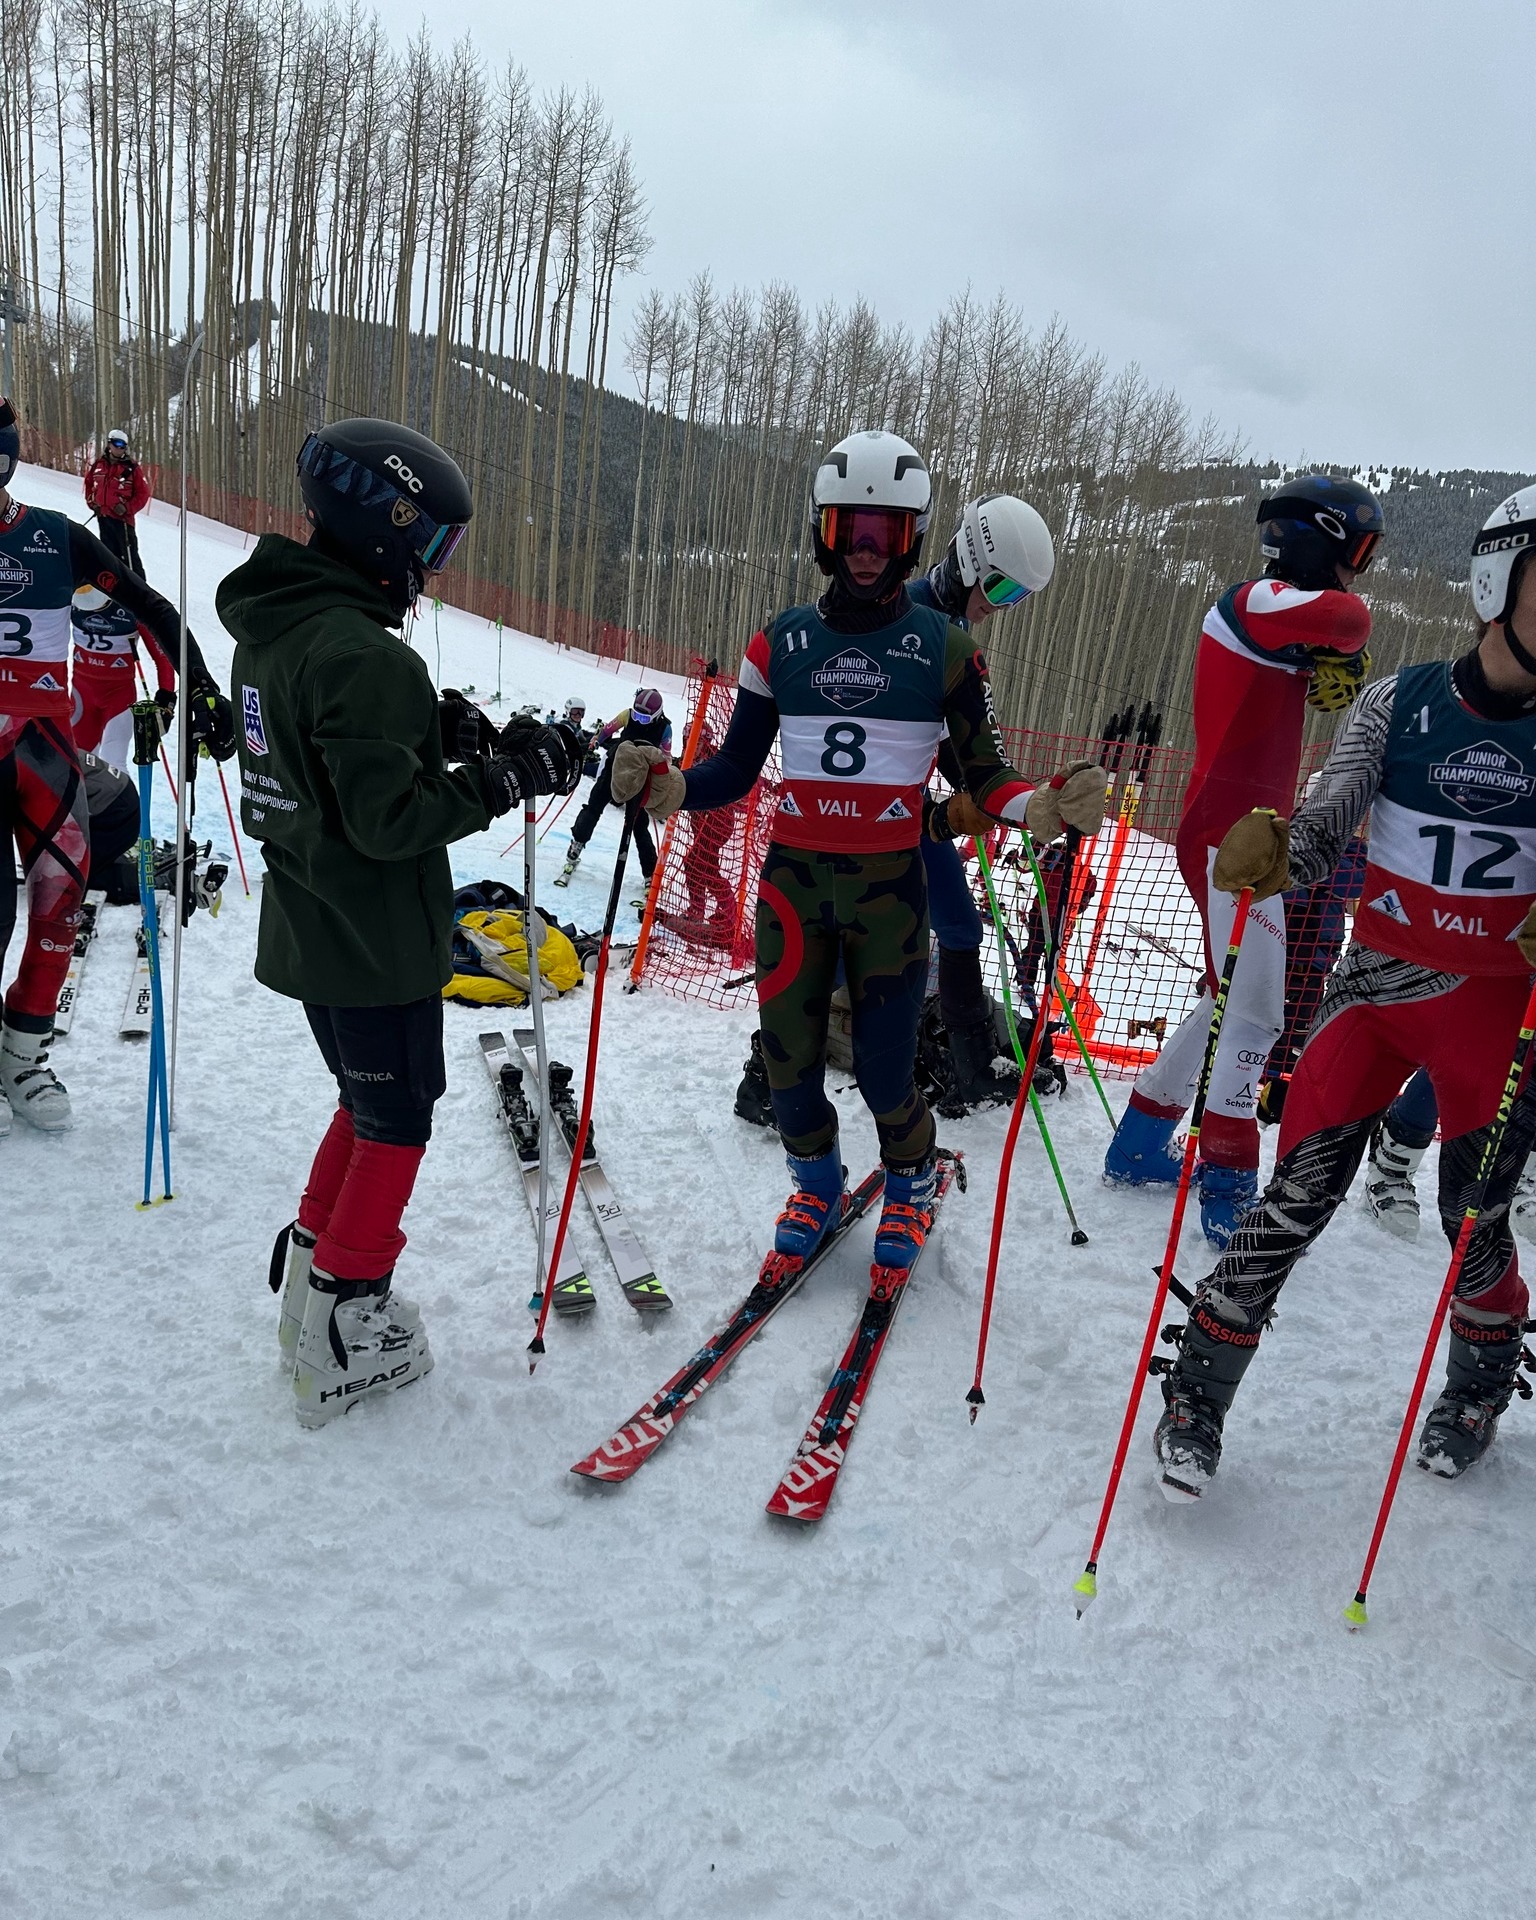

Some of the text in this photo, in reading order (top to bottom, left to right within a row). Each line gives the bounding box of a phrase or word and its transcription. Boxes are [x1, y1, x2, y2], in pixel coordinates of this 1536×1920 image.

[384, 454, 424, 494] POC
[1503, 497, 1521, 523] POC
[965, 525, 981, 573] GIRO
[1477, 533, 1530, 555] GIRO
[87, 657, 106, 667] VAIL
[835, 657, 868, 670] JUNIOR
[886, 648, 912, 659] Alpine
[815, 672, 886, 688] CHAMPIONSHIPS
[243, 689, 259, 714] US
[820, 721, 867, 777] 8
[1463, 750, 1507, 769] JUNIOR
[537, 747, 558, 783] SKI TEAM
[1434, 766, 1529, 792] CHAMPIONSHIPS
[251, 789, 299, 813] CHAMPIONSHIP
[817, 798, 862, 817] VAIL
[143, 839, 154, 893] GABEL
[1418, 823, 1522, 890] 12
[1432, 908, 1489, 936] VAIL
[56, 987, 75, 1013] HEAD
[136, 989, 151, 1014] HEAD
[348, 1068, 394, 1082] ARCTICA
[1235, 1064, 1252, 1072] Audi
[1497, 1061, 1523, 1122] LEKI
[1208, 1218, 1233, 1240] LAN
[1196, 1309, 1260, 1346] ROSSIGNO
[320, 1361, 412, 1404] HEAD
